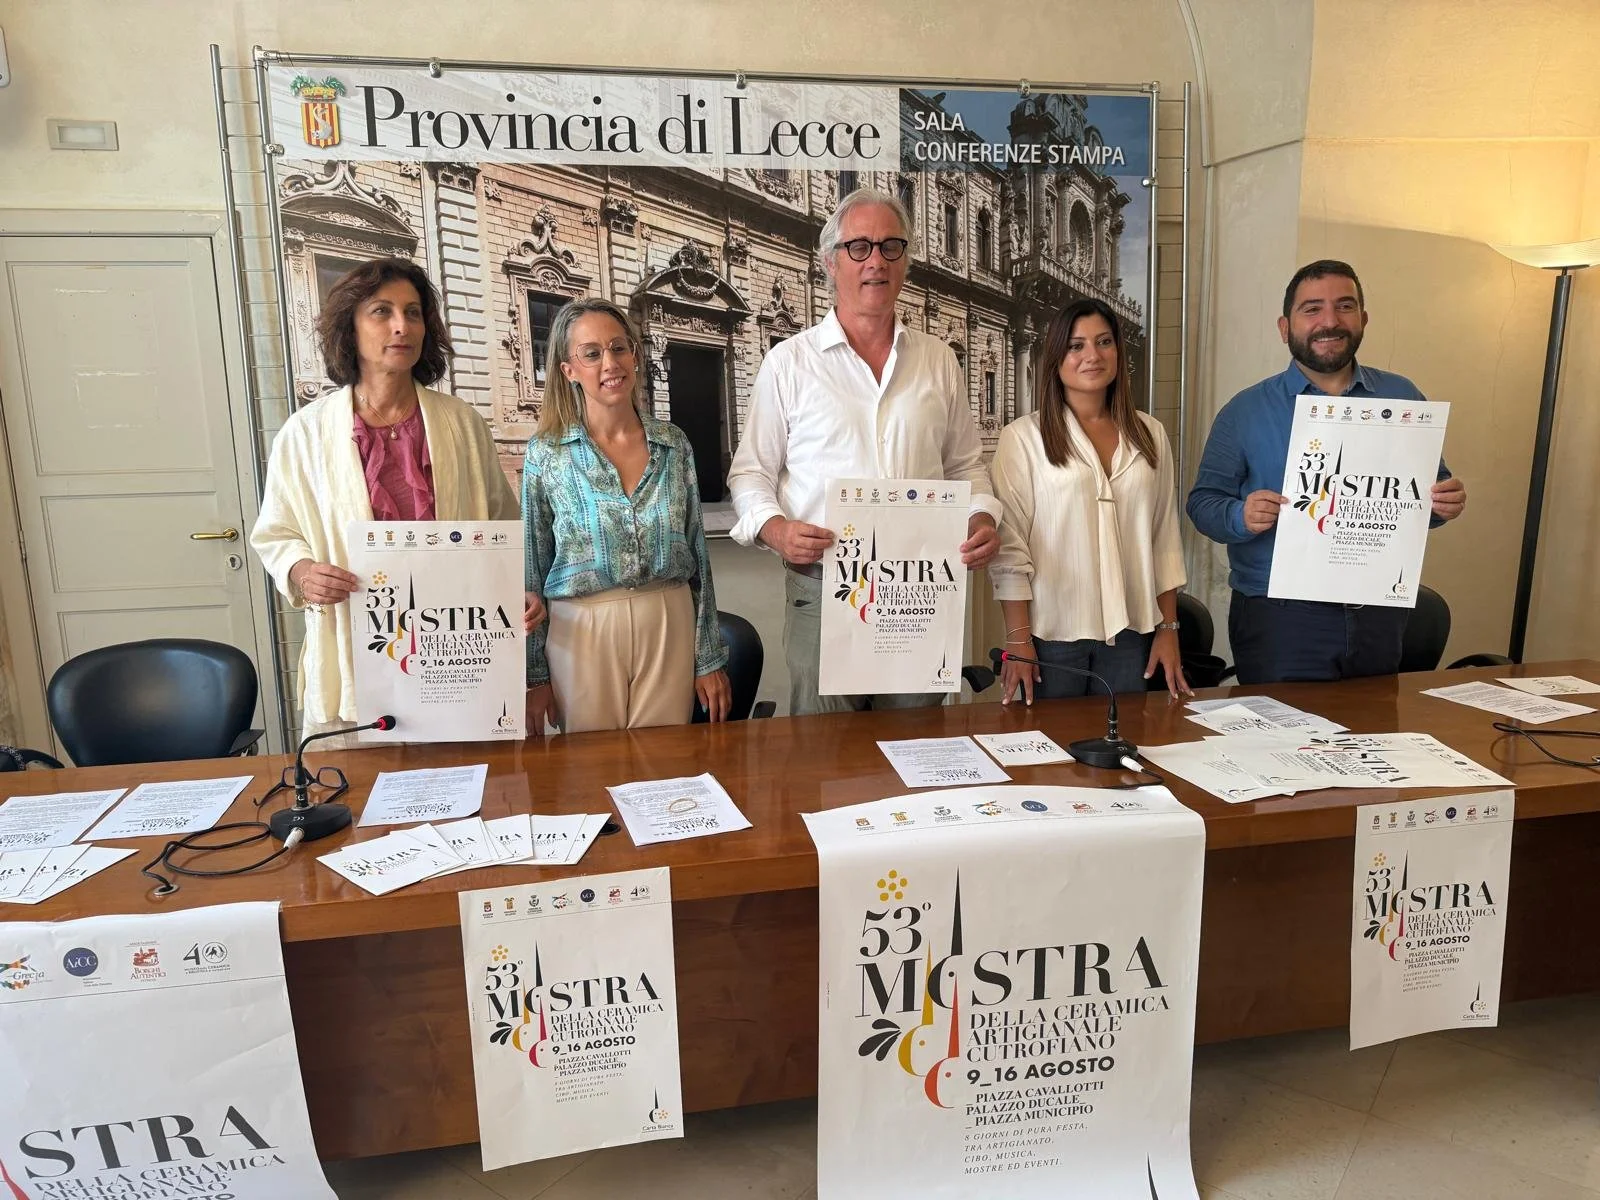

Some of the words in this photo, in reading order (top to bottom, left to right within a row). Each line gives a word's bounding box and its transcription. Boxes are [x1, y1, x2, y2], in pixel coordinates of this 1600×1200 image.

[355, 85, 644, 153] Provincia
[658, 94, 713, 154] di
[724, 96, 881, 159] Lecce
[914, 111, 965, 131] SALA
[914, 141, 1042, 164] CONFERENZE
[1048, 145, 1125, 166] STAMPA
[1294, 472, 1423, 500] MOSTRA
[1338, 498, 1370, 507] DELLA
[1374, 500, 1422, 510] CERAMICA
[1338, 506, 1402, 516] ARTIGIANALE
[1336, 512, 1398, 521] CUTROFIANO
[1358, 522, 1396, 530] AGOSTO
[834, 558, 957, 583] MOSTRA
[364, 605, 514, 634] MOSTRA
[420, 634, 458, 643] DELLA
[460, 631, 516, 641] CERAMICA
[420, 640, 494, 650] ARTIGIANALE
[420, 648, 491, 657] CUTROFIANO
[448, 657, 491, 666] AGOSTO
[1363, 880, 1497, 920] MOSTRA
[1406, 918, 1474, 931] ARTIGIANALE
[1408, 912, 1440, 924] DELLA
[1444, 908, 1496, 919] CERAMICA
[1406, 926, 1471, 939] CUTROFIANO
[1429, 935, 1470, 946] AGOSTO
[854, 936, 1168, 1019] MOSTRA
[484, 972, 662, 1023] MOSTRA
[550, 1011, 594, 1025] DELLA
[598, 1004, 664, 1016] CERAMICA
[970, 1007, 1048, 1029] DELLA
[1053, 995, 1170, 1021] CERAMICA
[550, 1015, 638, 1032] ARTIGIANALE
[966, 1015, 1122, 1046] ARTIGIANALE
[550, 1024, 635, 1042] CUTROFIANO
[585, 1036, 636, 1050] AGOSTO
[966, 1033, 1115, 1063] CUTROFIANO
[966, 1066, 1018, 1087] 9_16
[1024, 1056, 1115, 1080] AGOSTO
[976, 1090, 1022, 1103] PIAZZA
[1025, 1081, 1104, 1098] CAVALLOTTI
[966, 1100, 1025, 1116] PALAZZO
[975, 1113, 1022, 1127] PIAZZA
[1024, 1104, 1093, 1121] MUNICIPIO
[973, 1130, 1009, 1141] GIORNI
[1027, 1126, 1052, 1134] PURA
[964, 1144, 982, 1152] TRA
[34, 1174, 133, 1191] DELLA
[140, 1154, 286, 1180] CERAMICA
[964, 1163, 1003, 1174] MOSTRE
[1007, 1162, 1020, 1170] ED
[42, 1172, 232, 1200] ARTIGIANALE
